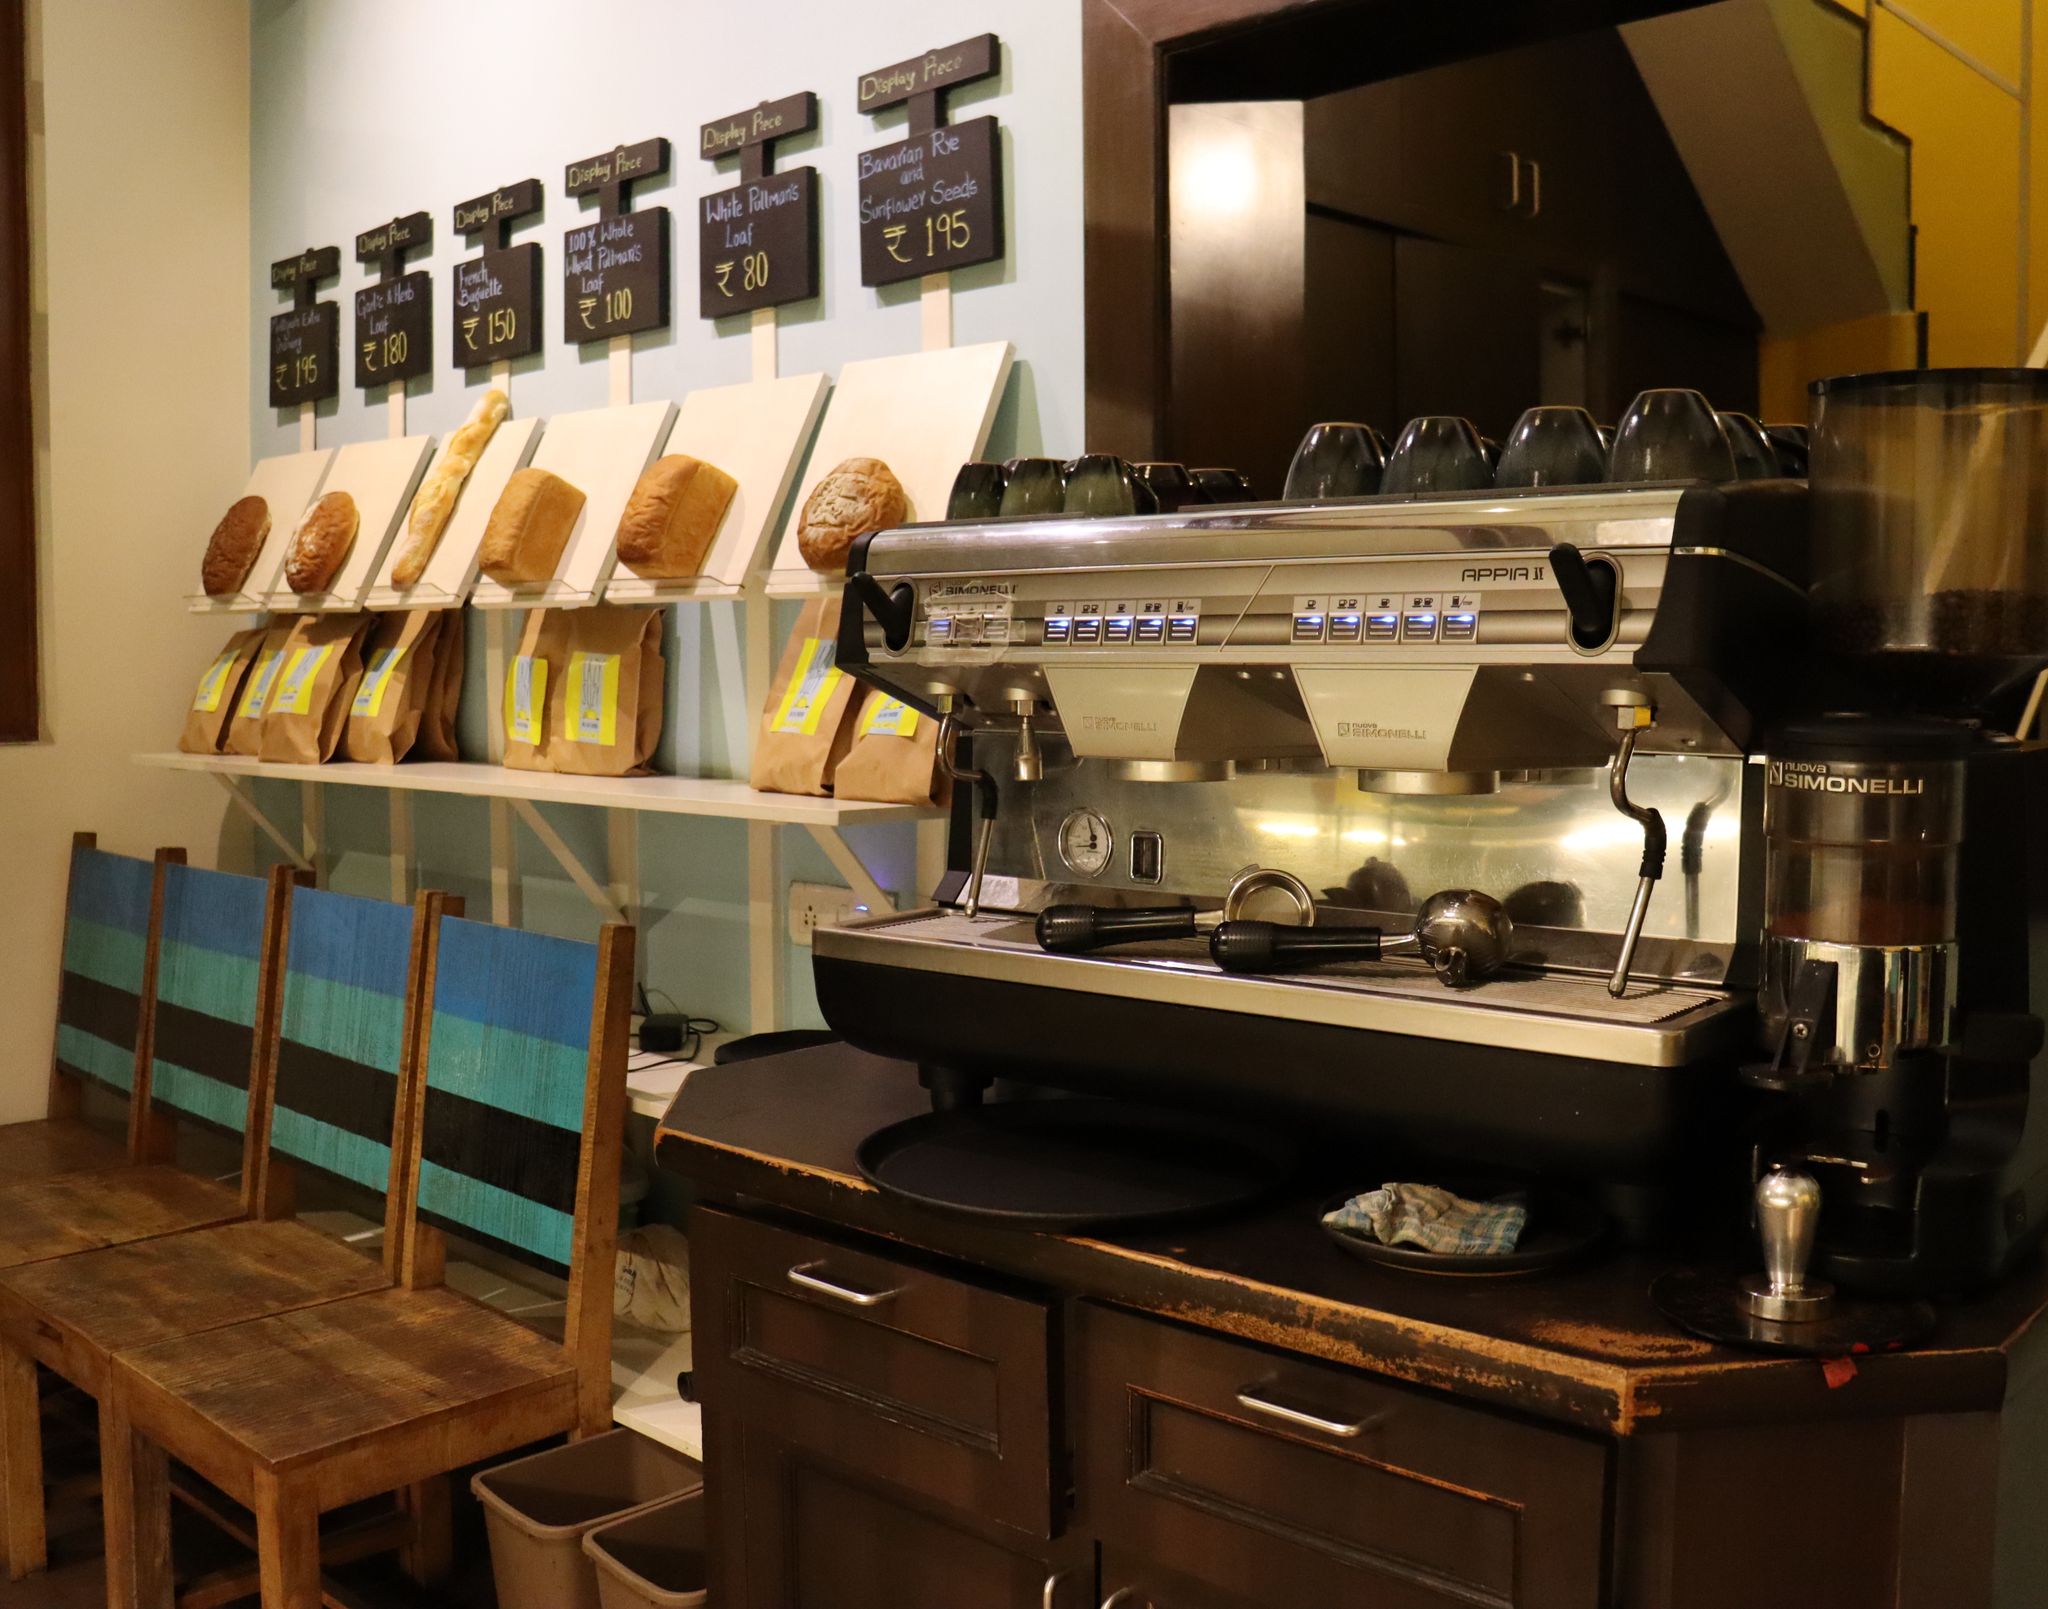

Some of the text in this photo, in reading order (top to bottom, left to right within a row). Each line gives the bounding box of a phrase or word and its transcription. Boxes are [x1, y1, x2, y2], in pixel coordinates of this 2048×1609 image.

[861, 55, 963, 101] Display Piece
[703, 111, 783, 150] Display Piece
[569, 152, 643, 188] Display Piece
[858, 131, 960, 181] Bavarian Rye
[899, 165, 924, 186] and
[706, 191, 743, 224] White
[860, 171, 978, 224] Sunflower Seeds
[456, 205, 489, 228] Display
[926, 210, 971, 257] 195
[569, 219, 634, 253] 100% Whole
[725, 222, 754, 248] Loaf
[459, 260, 488, 290] French
[565, 251, 593, 277] Wheat
[743, 251, 769, 291] 80
[459, 277, 502, 312] Baguette
[582, 273, 604, 295] Loaf
[605, 288, 632, 323] 100
[488, 308, 516, 344] 150
[384, 331, 408, 367] 180
[296, 355, 317, 387] 195
[1462, 568, 1528, 582] APPIA
[1784, 773, 1924, 795] SIMONELLI
[1785, 762, 1826, 774] nuova
